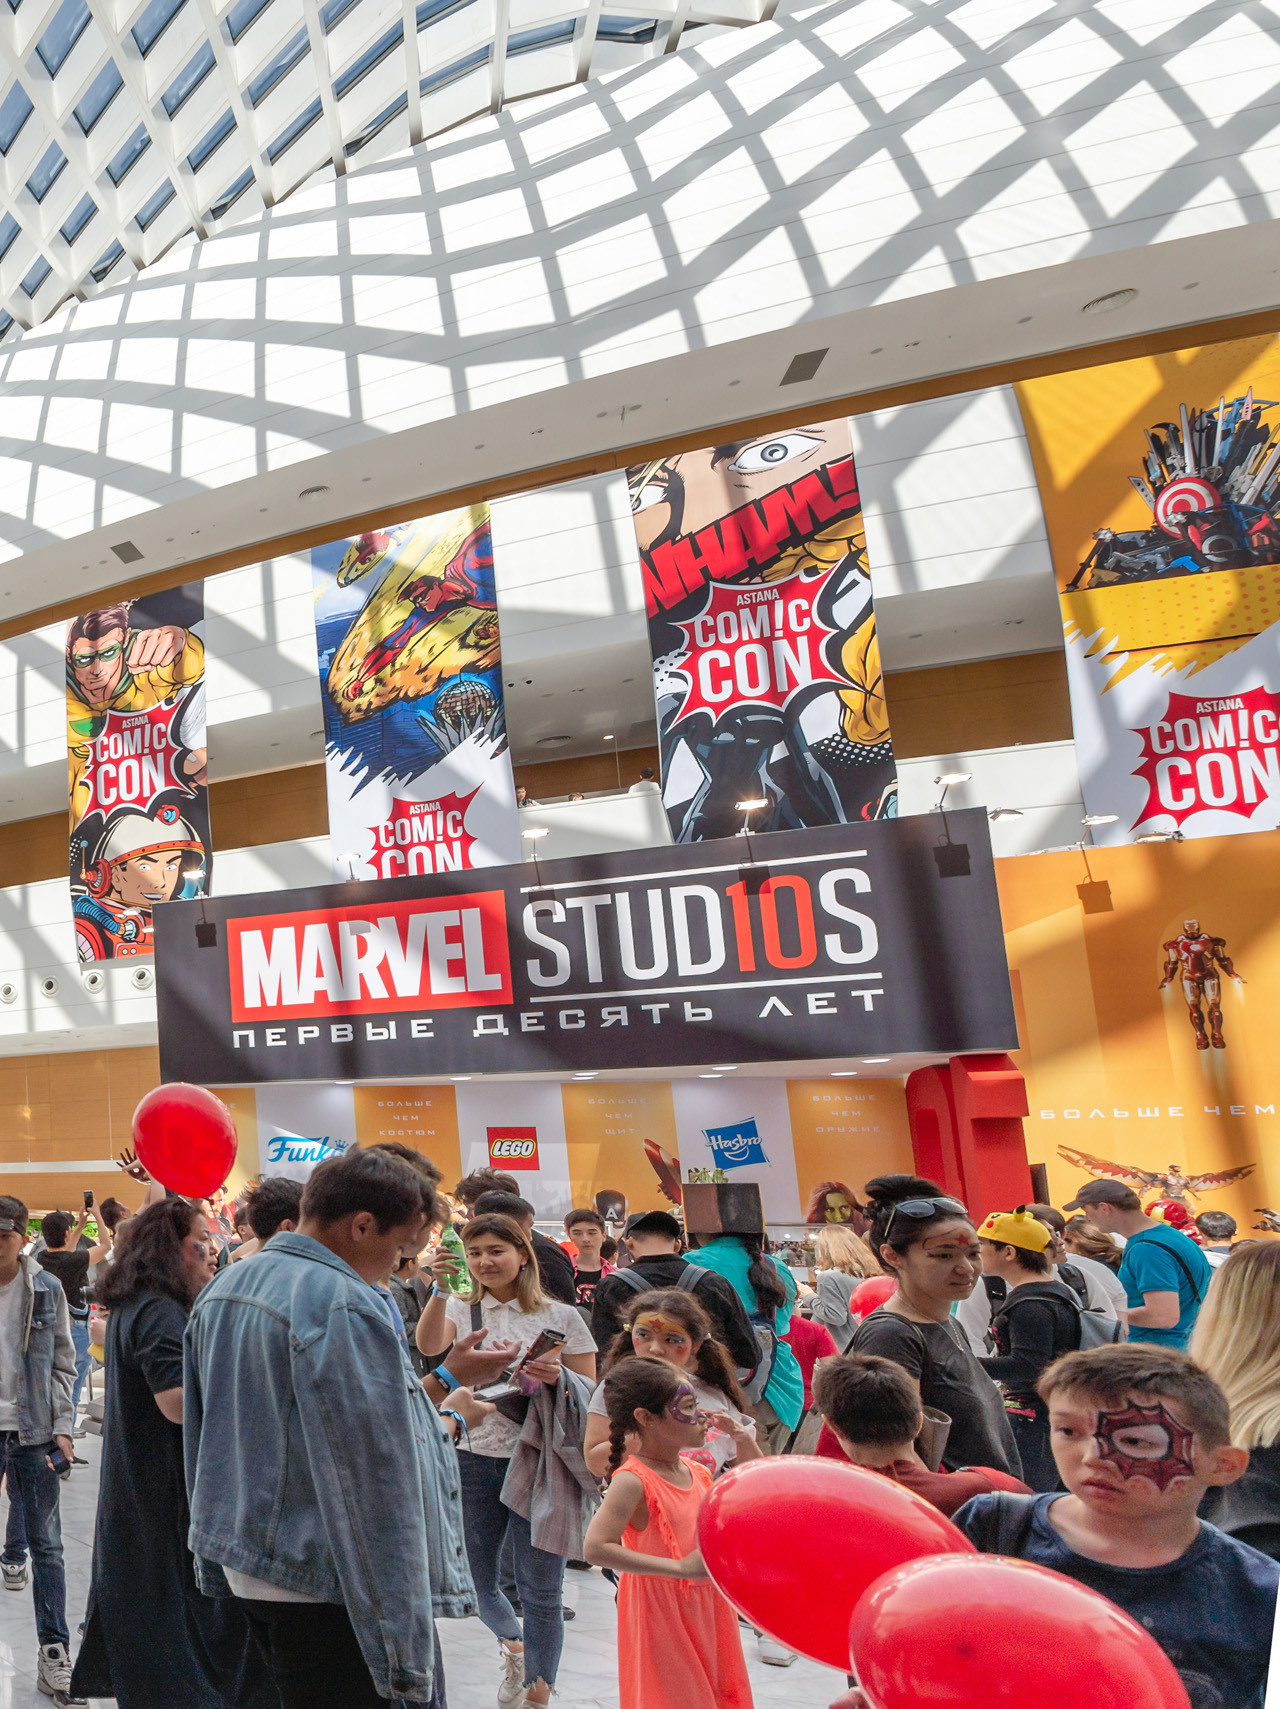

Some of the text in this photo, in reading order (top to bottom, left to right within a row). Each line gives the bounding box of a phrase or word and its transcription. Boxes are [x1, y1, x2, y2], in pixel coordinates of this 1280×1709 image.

[736, 589, 780, 606] ASTANA
[694, 599, 811, 648] COM!C
[698, 635, 813, 703] CON
[122, 715, 149, 729] ASTANA
[1196, 698, 1244, 714] ASTANA
[96, 723, 167, 762] COM!C
[1149, 709, 1279, 754] COM!C
[96, 752, 165, 806] CON
[1155, 747, 1280, 811] CON
[410, 802, 441, 815] ASTANA
[379, 810, 464, 848] COM!C
[381, 840, 463, 879] CON
[240, 907, 503, 1009] MARVEL
[233, 989, 884, 1049] ПЕРВЫЕ ДЕСЯТЬ ЛЕТ
[812, 1094, 875, 1102] БОЛЬШЕ
[1040, 1104, 1275, 1120] БОЛЬШЕ ЧЕМ
[492, 1140, 535, 1157] LEGO
[705, 1133, 762, 1150] Hasbro
